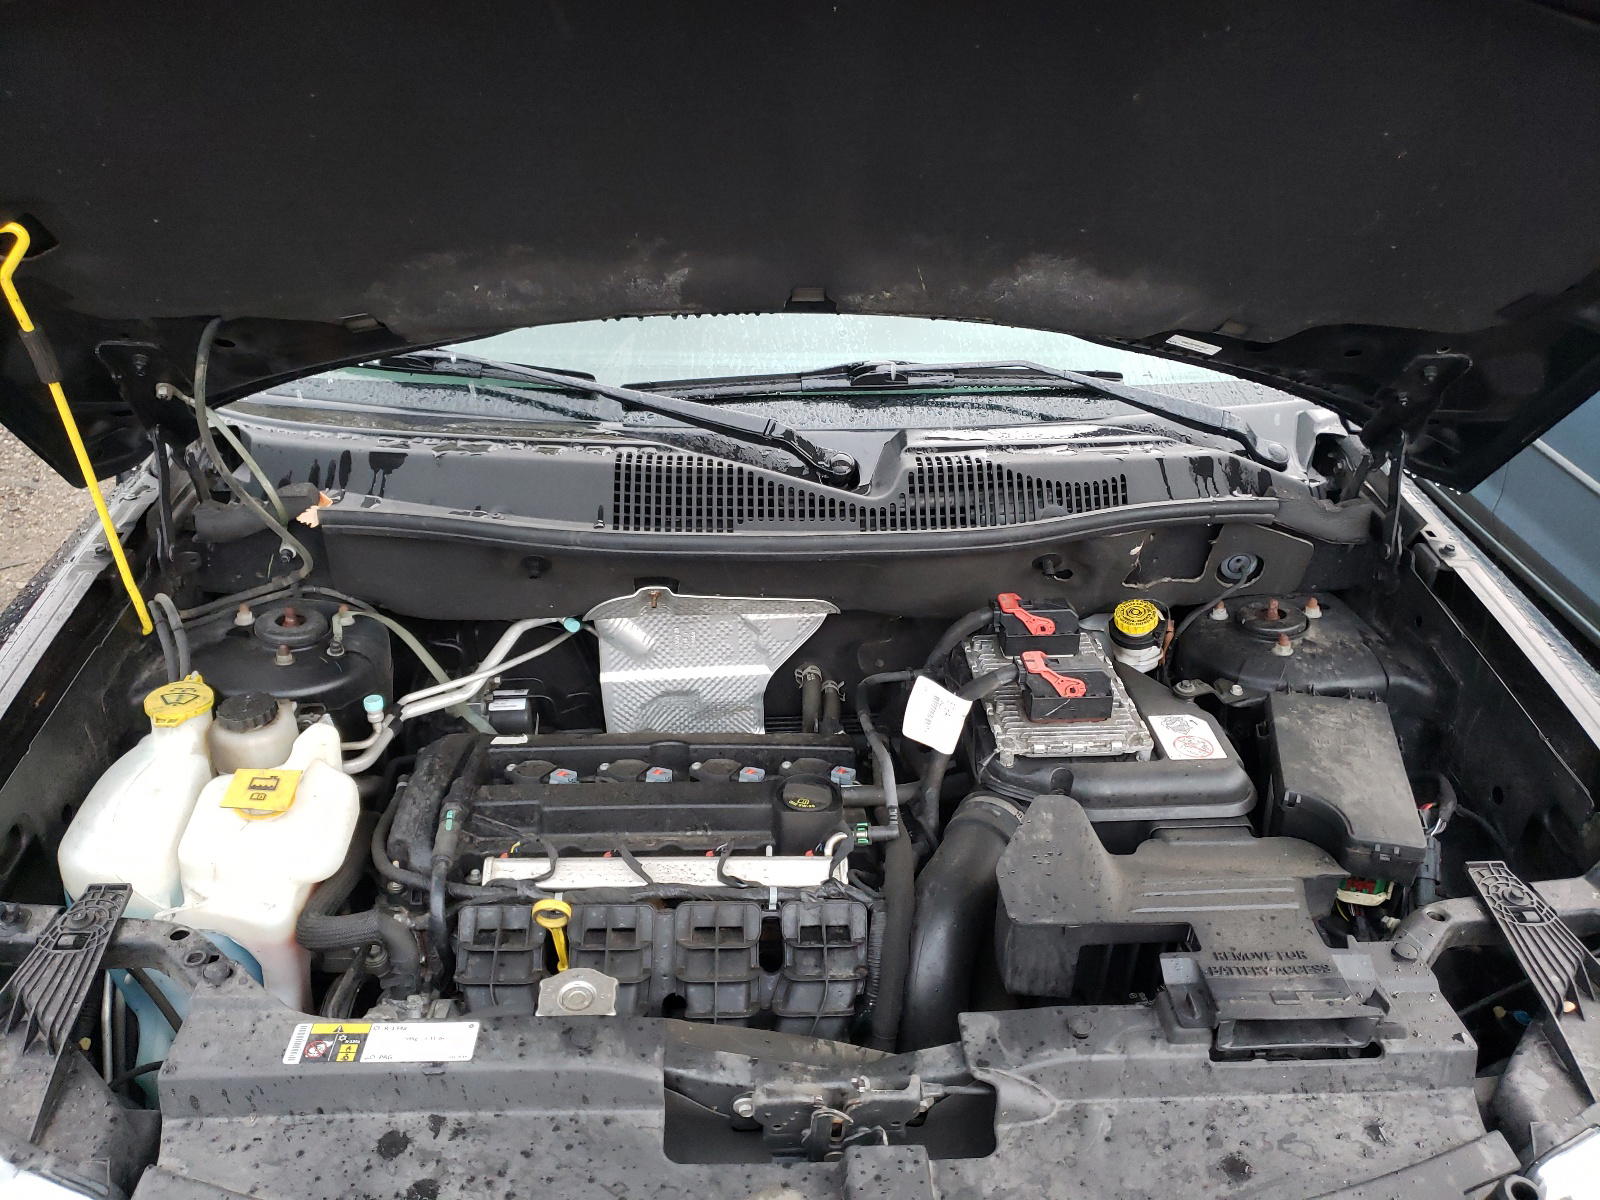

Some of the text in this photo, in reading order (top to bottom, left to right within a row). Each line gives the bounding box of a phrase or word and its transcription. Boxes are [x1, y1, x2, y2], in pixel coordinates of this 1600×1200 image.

[1213, 950, 1308, 961] REMOVE FOR
[1207, 964, 1332, 976] BATTERY ACCESS
